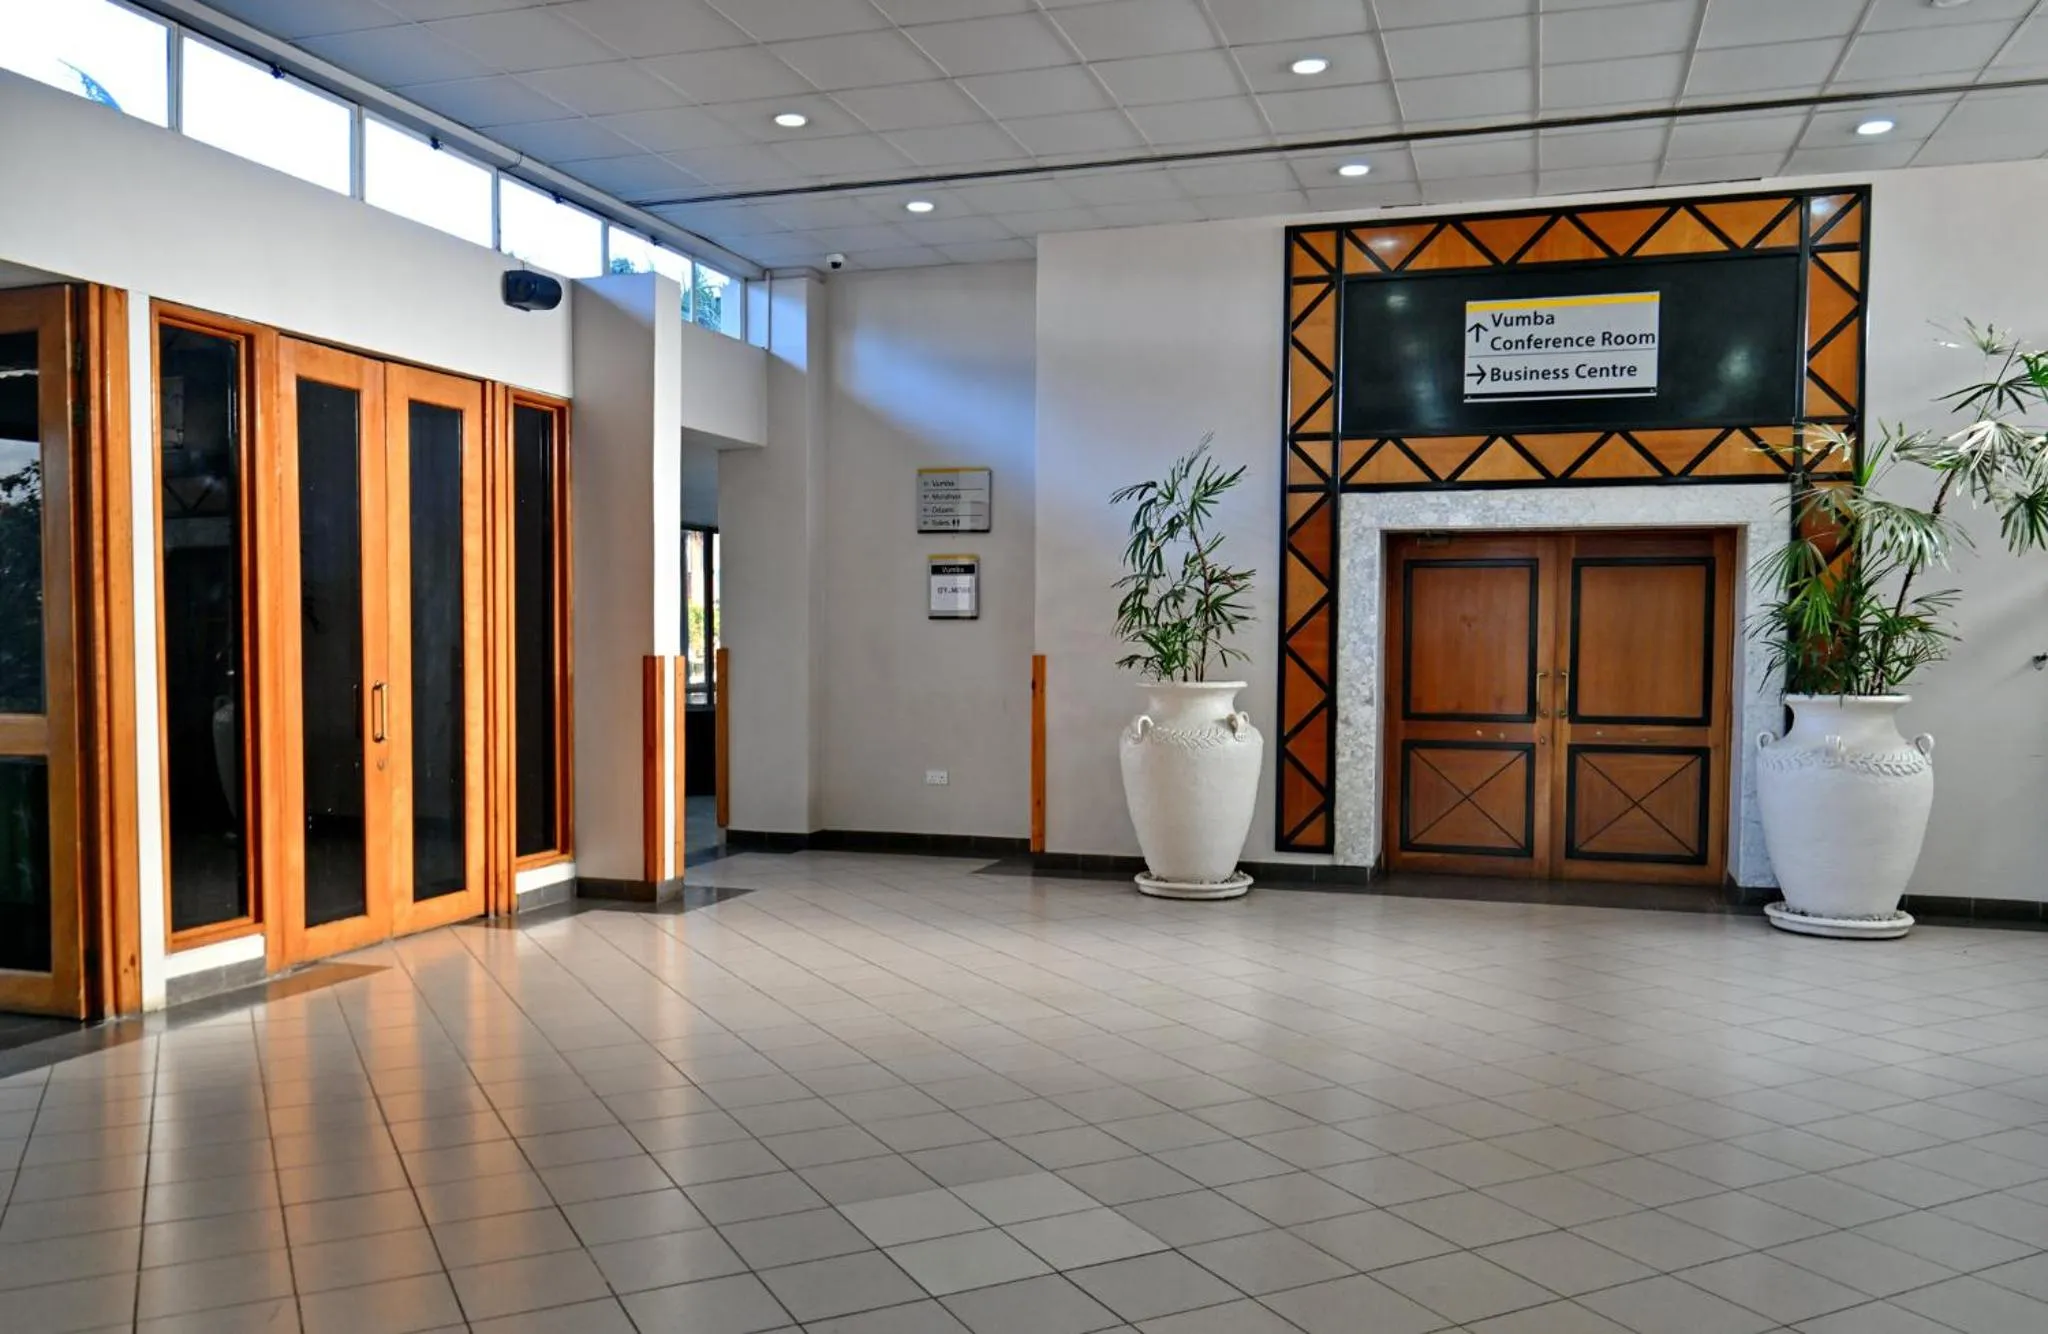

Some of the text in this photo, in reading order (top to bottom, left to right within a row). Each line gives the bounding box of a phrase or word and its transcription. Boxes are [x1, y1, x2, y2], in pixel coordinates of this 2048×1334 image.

[1491, 310, 1555, 328] Vumba
[1490, 331, 1656, 352] Conference Room
[1490, 363, 1638, 382] Business Centre
